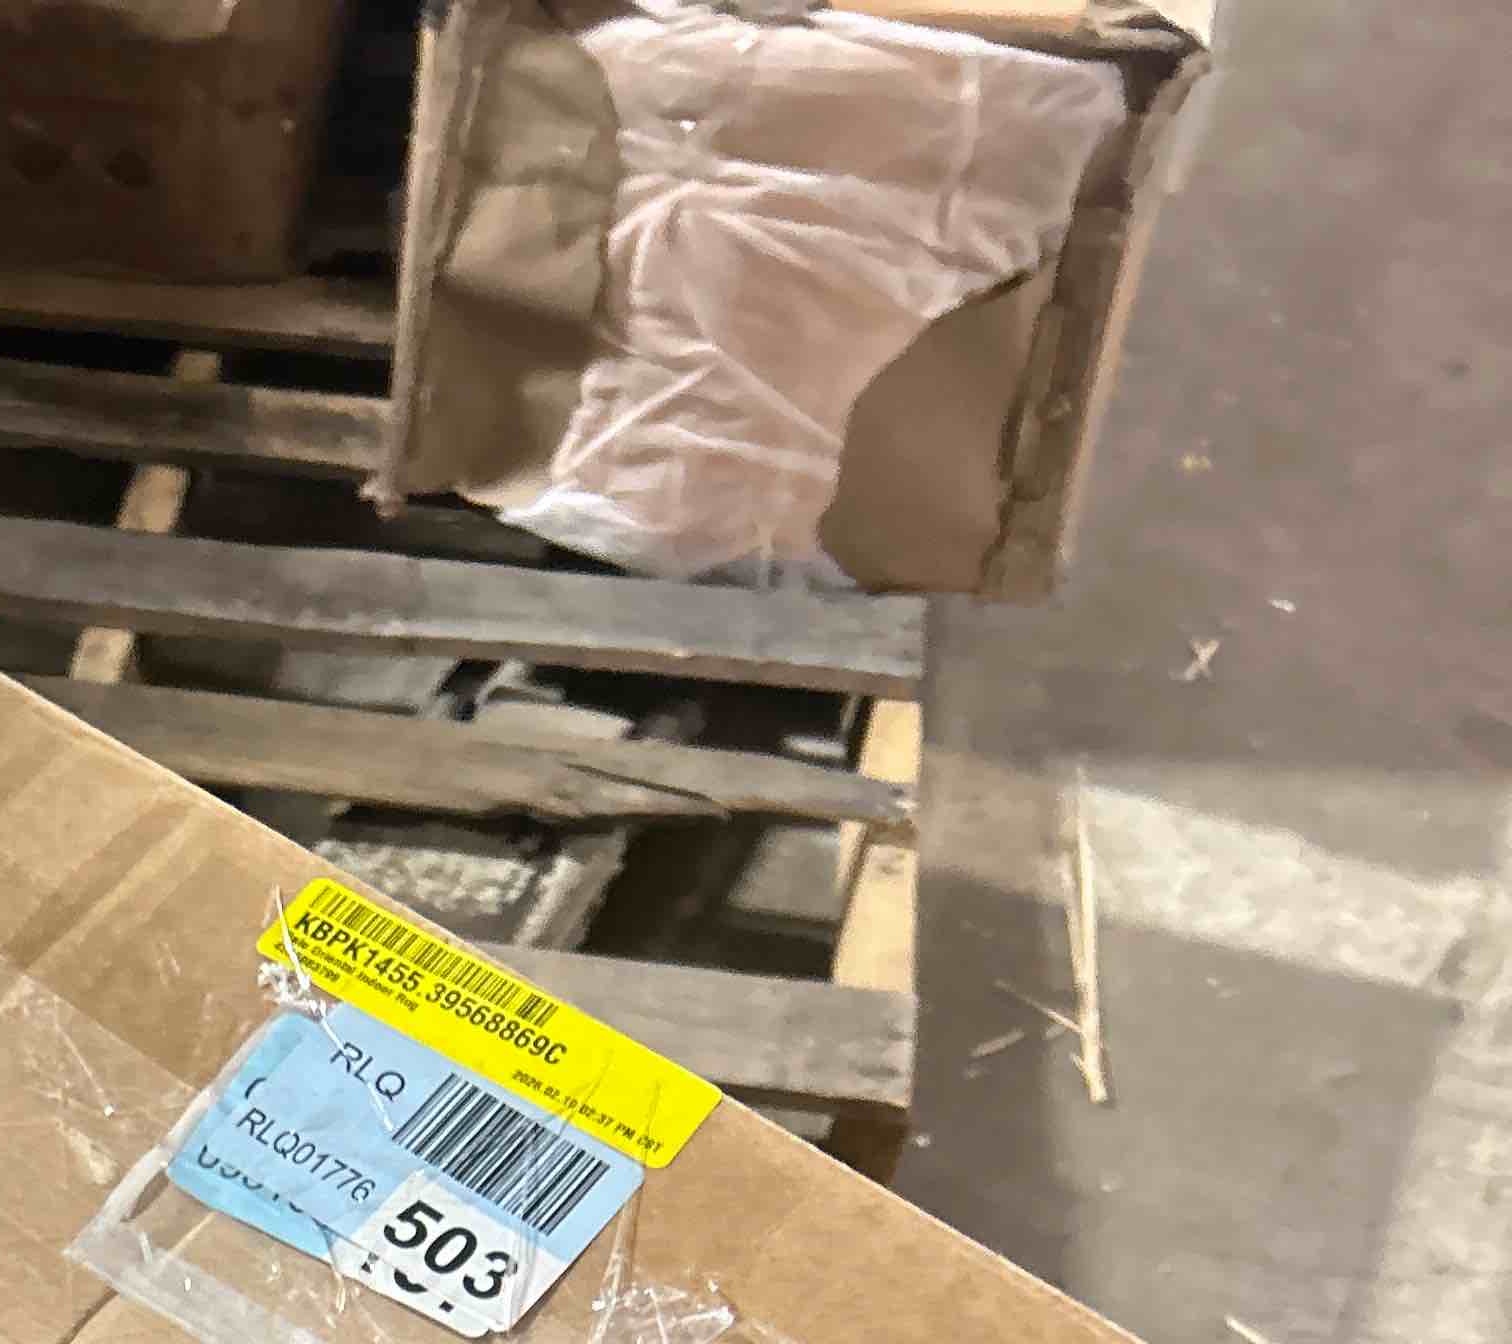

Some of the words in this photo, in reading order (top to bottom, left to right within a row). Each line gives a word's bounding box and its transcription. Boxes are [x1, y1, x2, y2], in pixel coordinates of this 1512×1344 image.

[294, 912, 567, 1065] KBPK1455.39568869C
[311, 946, 357, 974] Oriental
[358, 971, 393, 995] Indoor
[395, 992, 419, 1012] Rug
[330, 1042, 406, 1102] RLQ
[237, 1107, 376, 1201] RLQ01776
[614, 1122, 636, 1140] PM
[383, 1199, 518, 1299] 503
